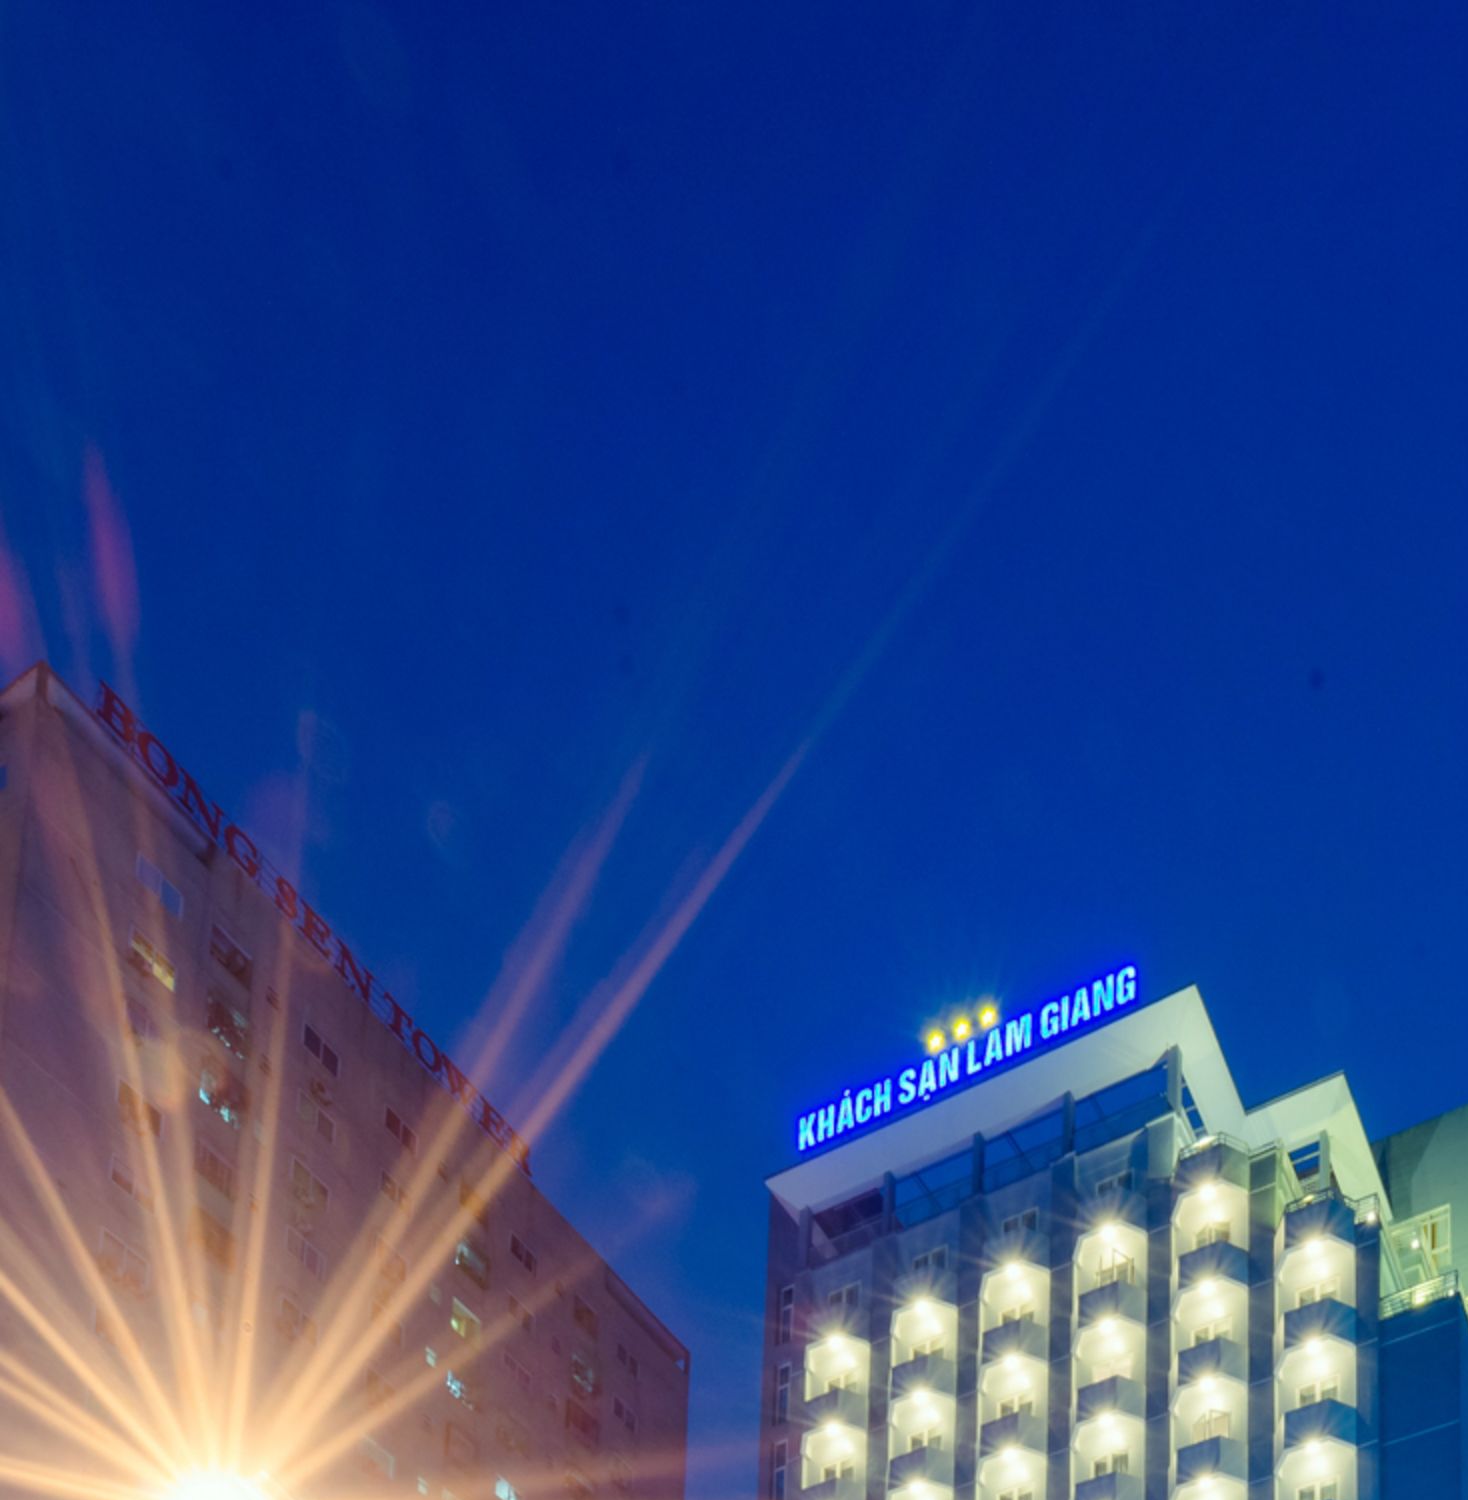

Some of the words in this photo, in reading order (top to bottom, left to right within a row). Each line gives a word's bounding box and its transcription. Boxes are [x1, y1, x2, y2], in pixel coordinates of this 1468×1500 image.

[275, 876, 375, 1001] SEN
[383, 992, 533, 1177] TOWER
[797, 1078, 892, 1152] KHÁCH
[898, 1047, 959, 1104] SẠN
[966, 1013, 1033, 1075] LAM
[1040, 965, 1137, 1040] GIANG
